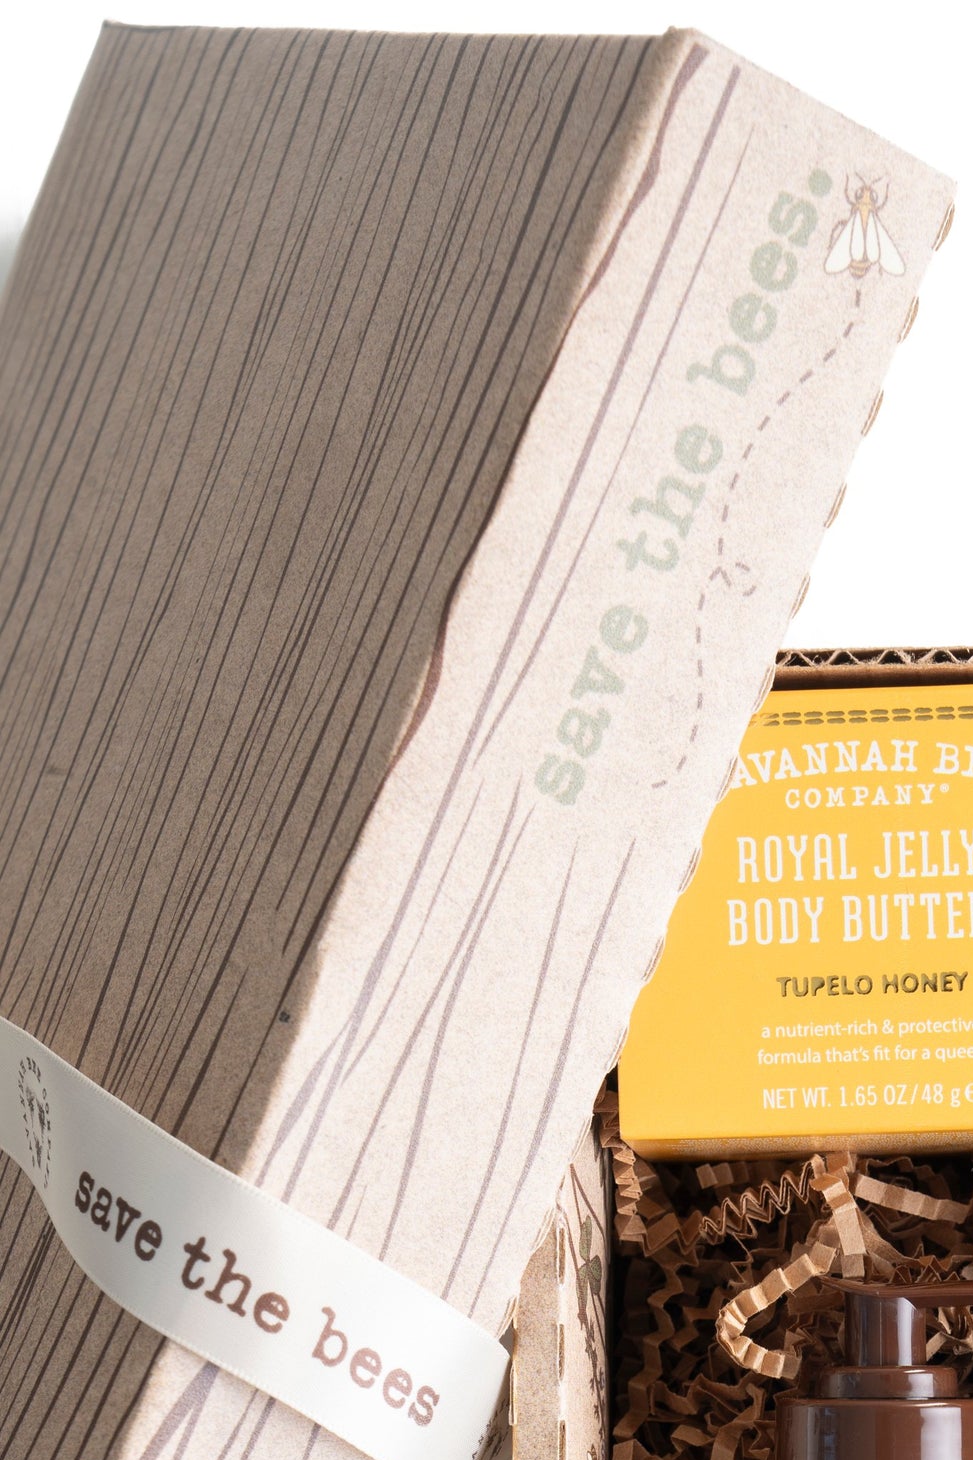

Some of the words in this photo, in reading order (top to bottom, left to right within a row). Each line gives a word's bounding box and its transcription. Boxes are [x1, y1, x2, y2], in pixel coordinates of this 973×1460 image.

[533, 602, 649, 807] save
[615, 422, 724, 573] the
[685, 166, 834, 397] bees.
[730, 739, 918, 790] AVANNAH
[737, 834, 857, 883] ROYAL
[727, 896, 824, 945] BODY
[778, 976, 872, 997] TUPELO
[884, 972, 968, 993] HONEY
[761, 1027, 771, 1038] a
[776, 1019, 878, 1038] nutrient-rich
[882, 1019, 894, 1034] &
[757, 1048, 821, 1064] formula
[825, 1047, 870, 1062] that's
[873, 1045, 890, 1060] fit
[895, 1044, 917, 1060] for
[921, 1048, 931, 1060] a
[763, 1088, 797, 1109] NET
[802, 1087, 831, 1107] WT.
[840, 1085, 878, 1107] 1.65
[74, 1170, 163, 1262] save
[180, 1236, 291, 1335] the
[312, 1308, 439, 1426] bees
